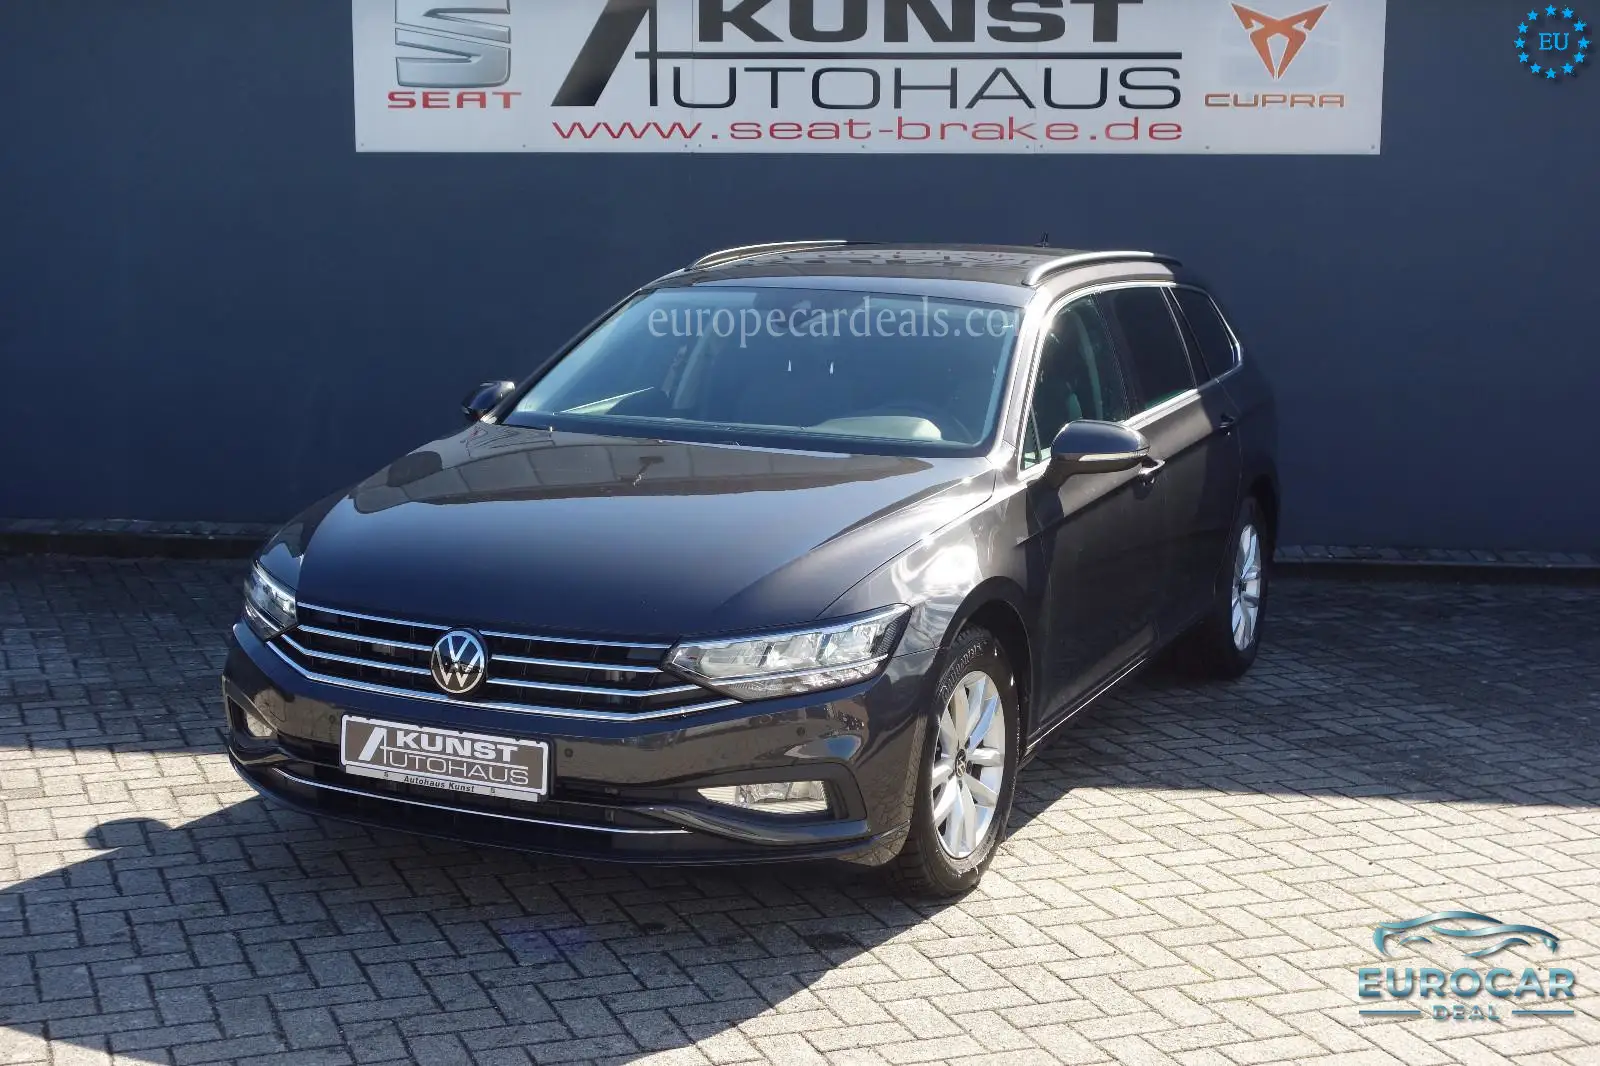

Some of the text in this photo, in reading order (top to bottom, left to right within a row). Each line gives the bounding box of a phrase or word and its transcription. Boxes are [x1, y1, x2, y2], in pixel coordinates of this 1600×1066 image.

[698, 0, 1143, 43] KUNST
[387, 91, 522, 109] SEAT
[1203, 93, 1346, 108] CUPRA
[551, 116, 1183, 141] www.seat-brake.de
[357, 726, 530, 786] AUTOHAUS
[396, 729, 519, 763] KUNST
[403, 775, 475, 793] Autohaus Kunst
